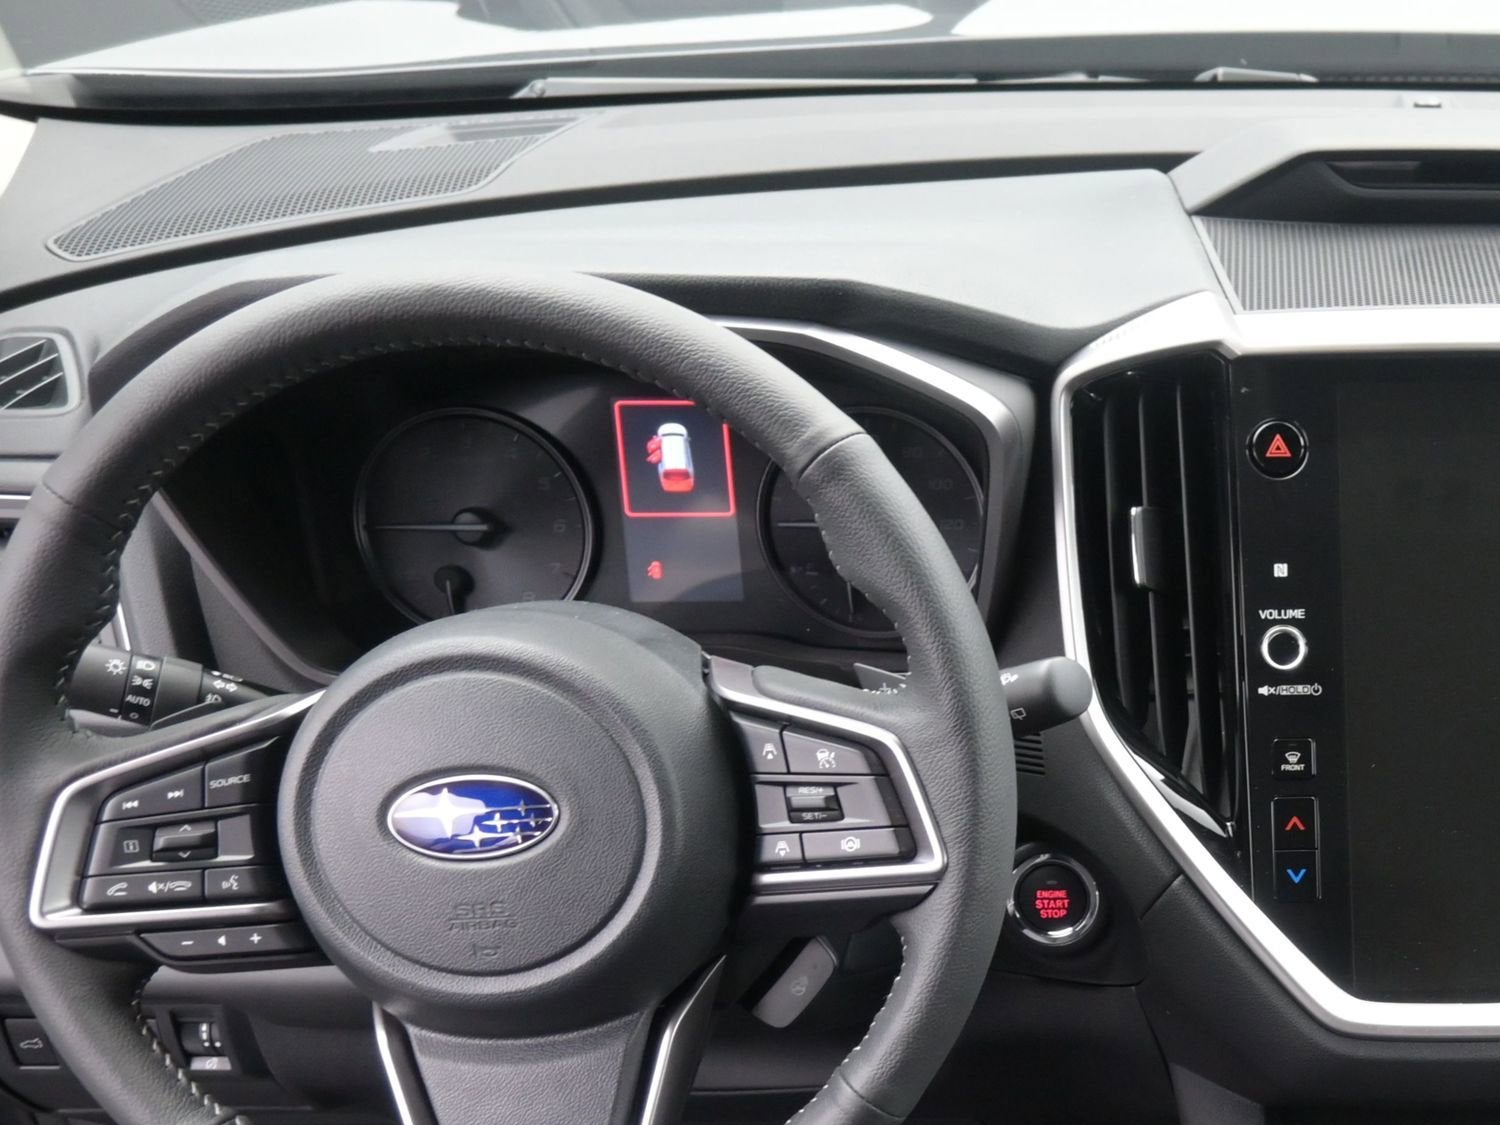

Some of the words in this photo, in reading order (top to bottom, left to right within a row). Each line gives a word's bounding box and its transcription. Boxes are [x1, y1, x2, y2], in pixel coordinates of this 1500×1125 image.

[1259, 609, 1306, 619] VOLUME
[1280, 685, 1310, 695] HOLD
[125, 694, 151, 707] AUTO
[1281, 763, 1305, 771] FRONT
[209, 774, 251, 789] SOURCE
[1036, 890, 1067, 898] ENGINE
[1035, 899, 1069, 909] START
[1040, 909, 1067, 918] STOP
